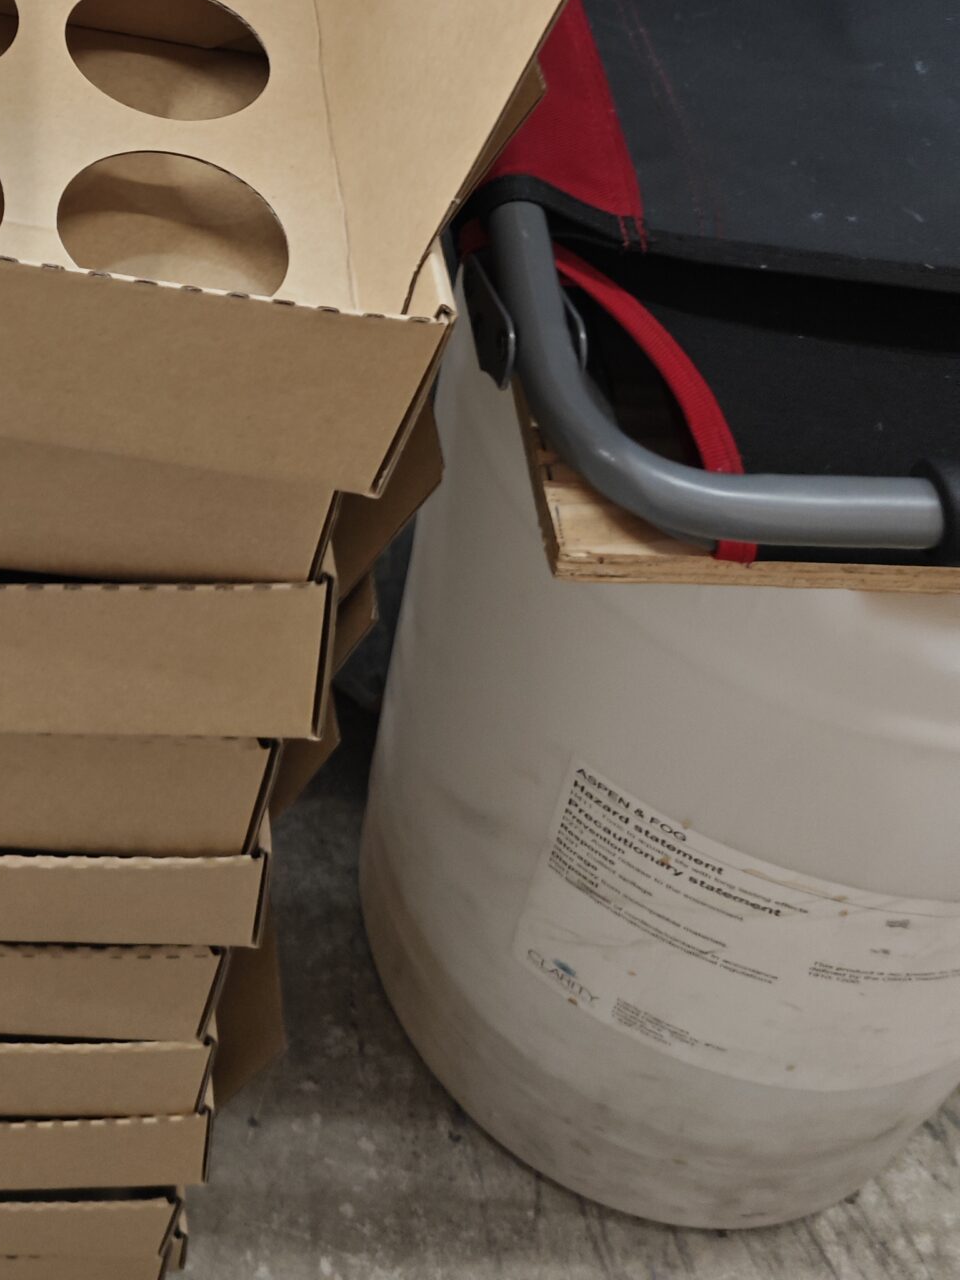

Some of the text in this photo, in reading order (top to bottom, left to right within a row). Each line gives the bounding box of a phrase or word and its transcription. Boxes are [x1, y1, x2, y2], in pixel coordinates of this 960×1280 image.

[568, 797, 782, 917] Precautionary statement
[573, 780, 723, 875] Hazard statement
[634, 808, 644, 819] &
[649, 817, 687, 842] FOG
